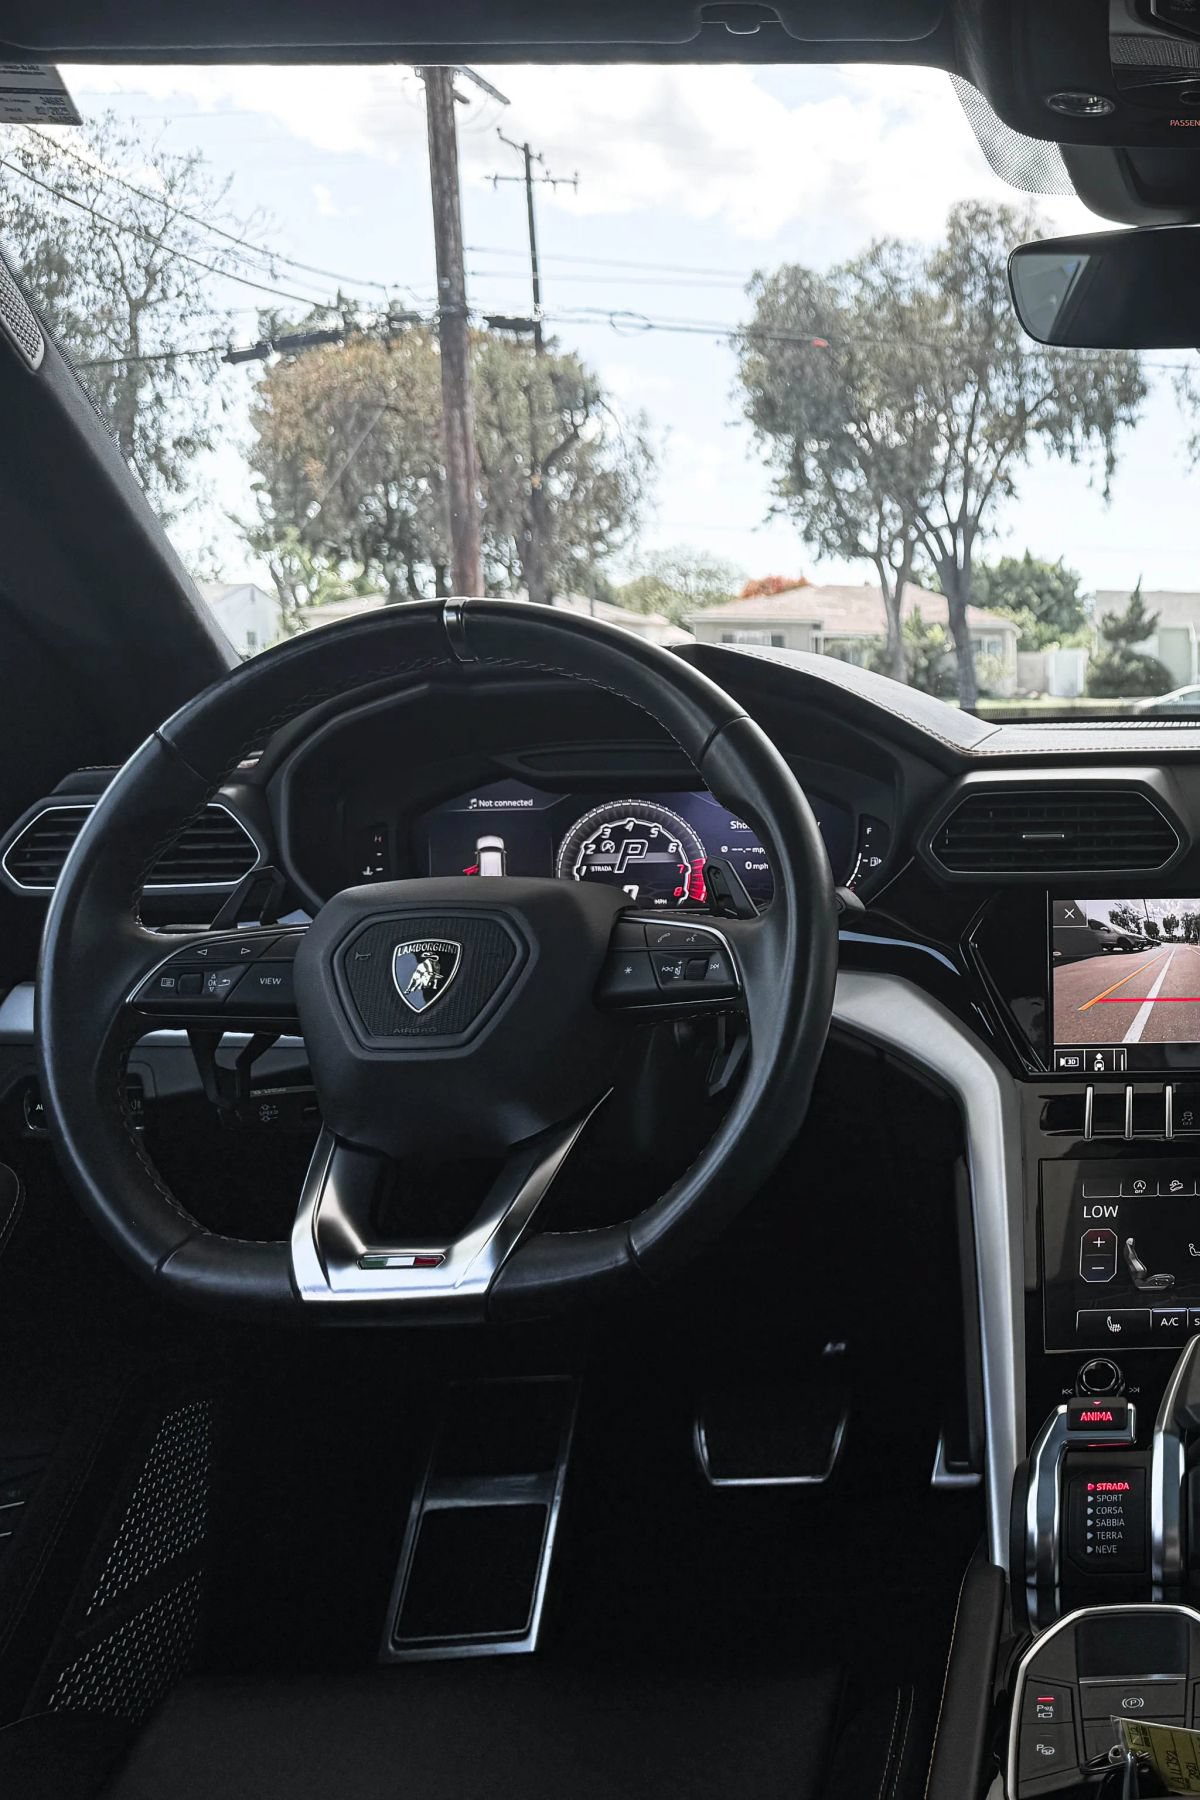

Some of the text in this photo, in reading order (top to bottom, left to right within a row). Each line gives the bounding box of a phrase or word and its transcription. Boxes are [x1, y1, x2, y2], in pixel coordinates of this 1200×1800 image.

[494, 799, 534, 807] connected
[625, 822, 635, 832] 4
[730, 820, 750, 830] Sho
[601, 828, 611, 839] 3
[650, 828, 660, 838] 5
[586, 844, 596, 855] 2
[668, 843, 677, 853] 6
[614, 839, 649, 874] P
[580, 866, 587, 877] 1
[677, 864, 684, 874] 7
[753, 862, 768, 871] mph
[674, 887, 682, 897] 8
[397, 943, 459, 956] LAMBORGHINI
[259, 977, 282, 985] VIEW
[1083, 1205, 1119, 1218] LOW
[1160, 1317, 1179, 1327] A/C
[1080, 1411, 1113, 1422] ANIMA
[1096, 1482, 1130, 1491] STRADA
[1096, 1494, 1123, 1502] SPORT
[1096, 1506, 1123, 1514] CORSA
[1096, 1518, 1125, 1527] SABBIA
[1096, 1531, 1123, 1540] TERRA
[1095, 1544, 1117, 1553] NEVE
